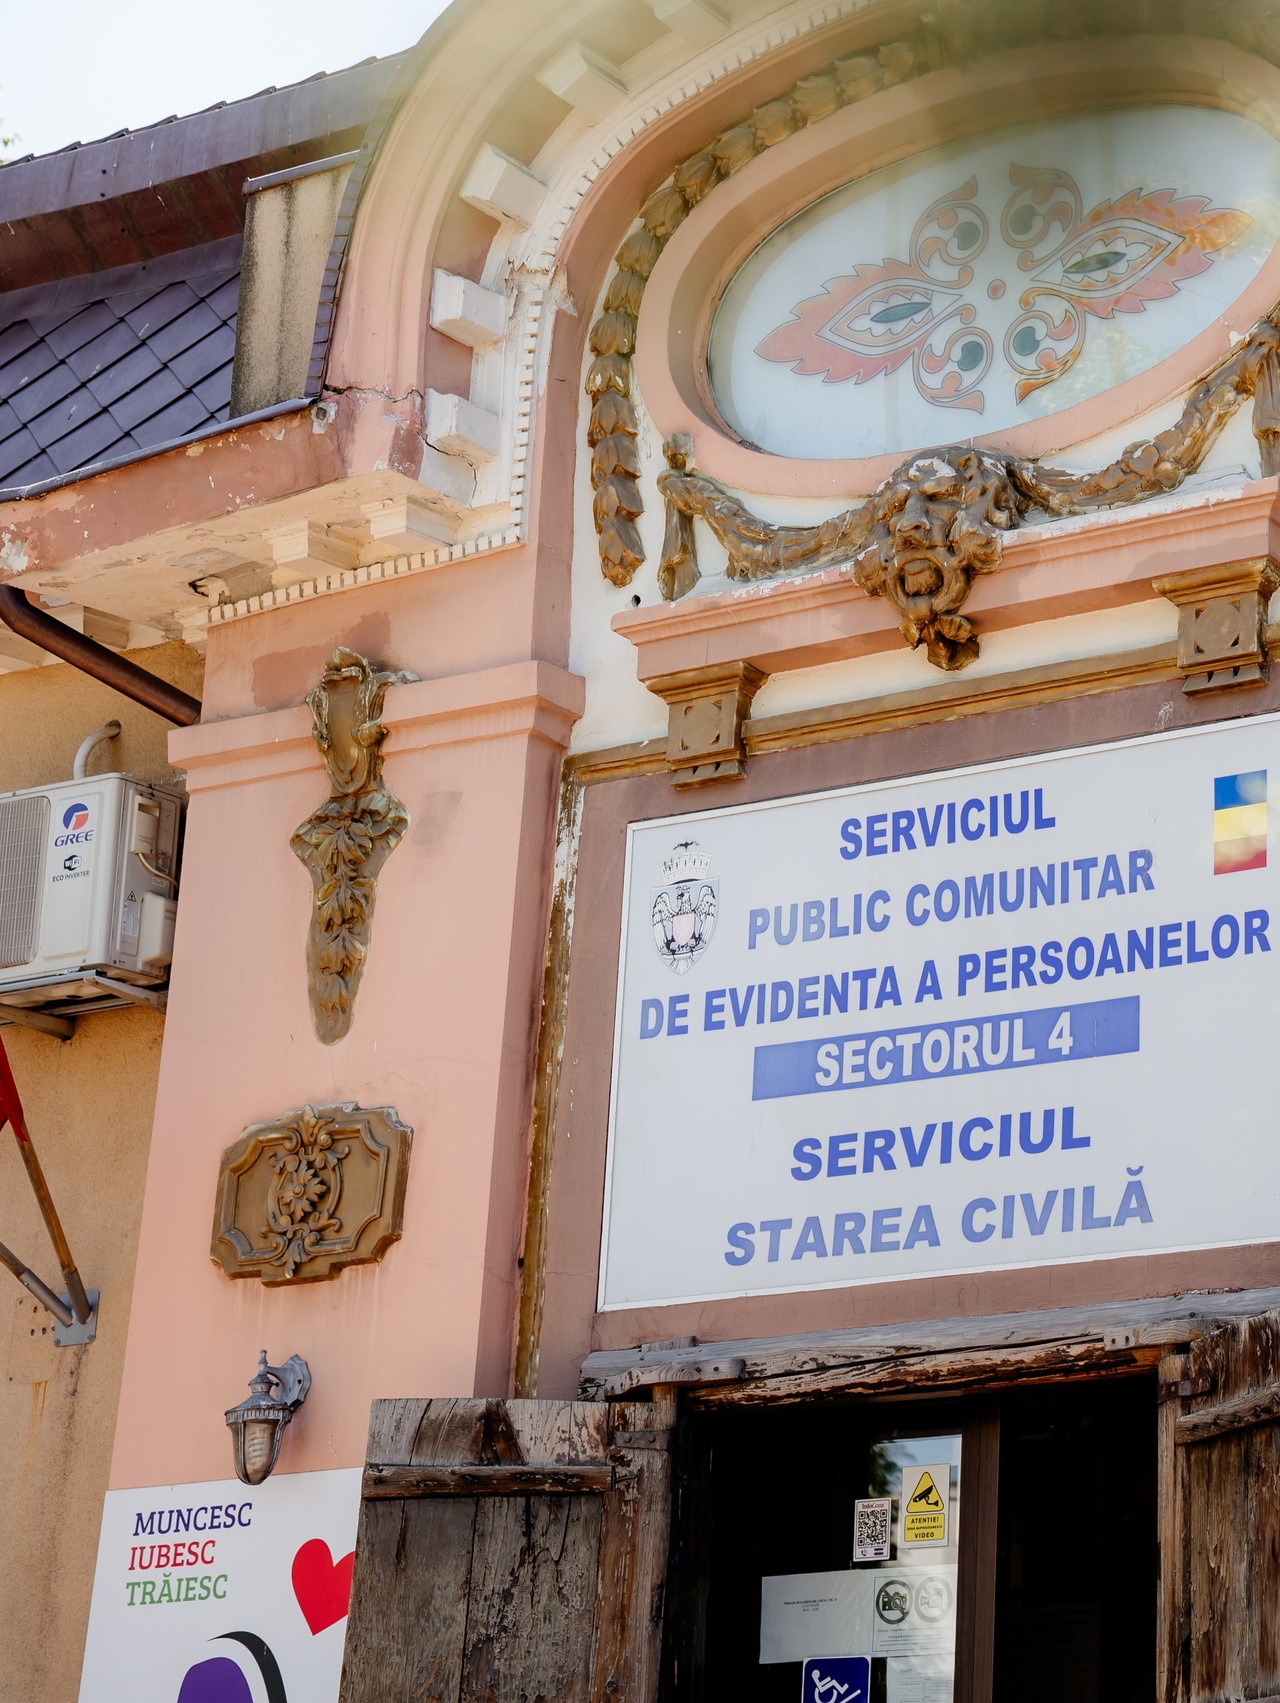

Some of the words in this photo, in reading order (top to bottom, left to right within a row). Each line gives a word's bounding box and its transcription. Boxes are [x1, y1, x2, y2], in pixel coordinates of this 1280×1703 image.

[54, 830, 95, 847] GREE
[840, 787, 1056, 861] SERVICIUL
[52, 875, 65, 883] ECO
[65, 870, 90, 880] INVERTER
[748, 891, 891, 950] PUBLIC
[905, 849, 1156, 927] COMUNITAR
[639, 995, 690, 1040] DE
[703, 966, 901, 1032] EVIDENTA
[915, 959, 943, 1004] A
[958, 909, 1272, 997] PERSOANELOR
[814, 1016, 1036, 1088] SECTORUL
[1047, 1011, 1075, 1056] 4
[790, 1107, 1091, 1182] SERVICIUL
[724, 1205, 941, 1267] STAREA
[960, 1165, 1155, 1243] CIVILĂ
[132, 1502, 253, 1537] MUNCESC
[914, 1531, 935, 1539] VIDEO
[128, 1539, 216, 1571] IUBESC
[125, 1571, 229, 1607] TRĂIESC
